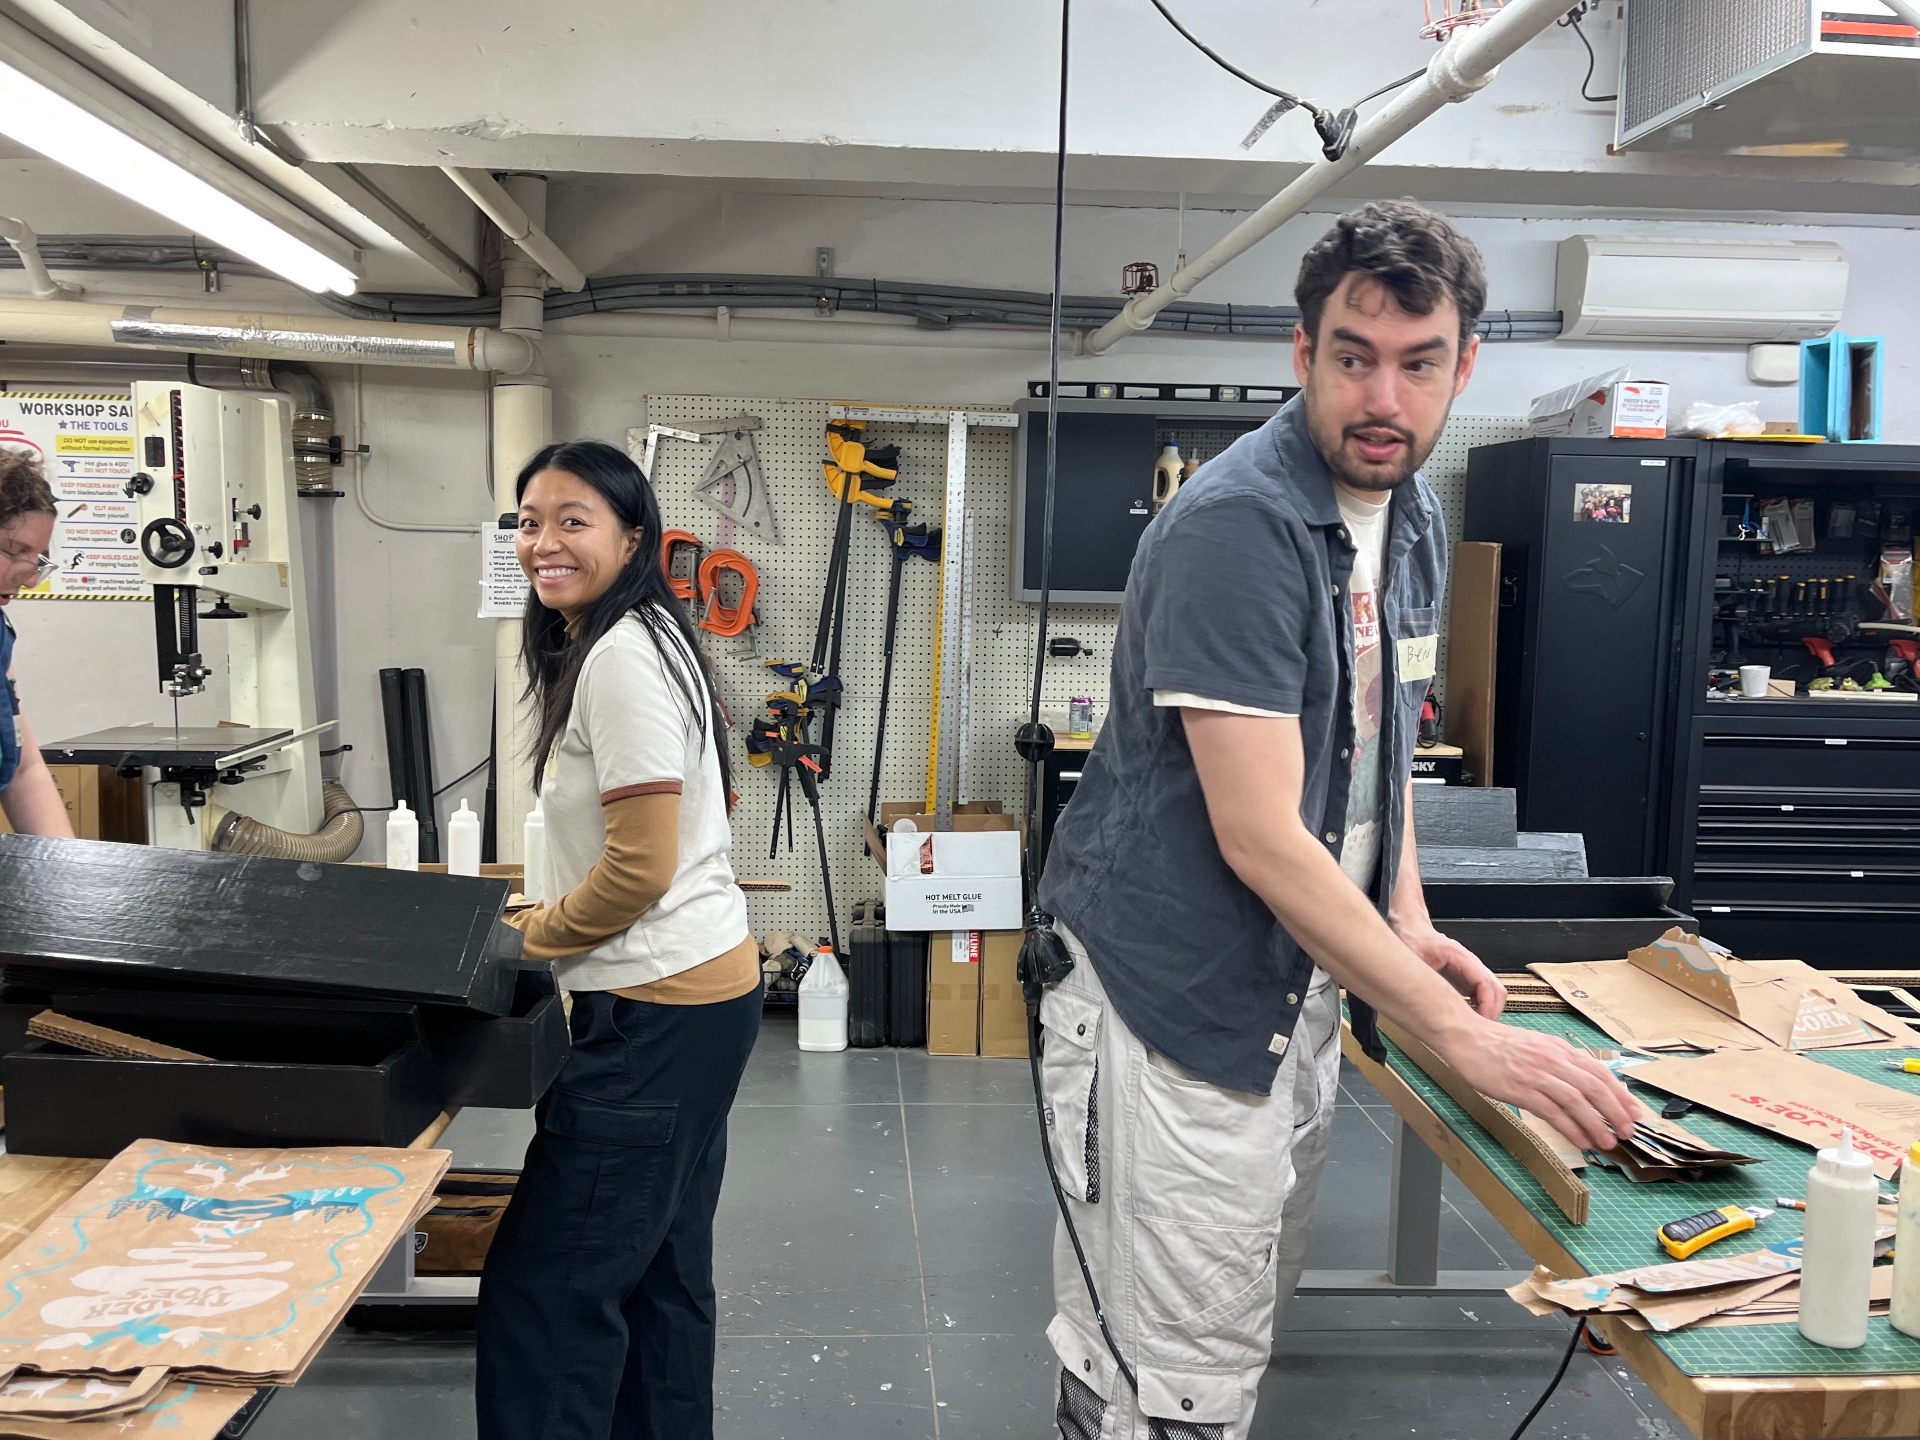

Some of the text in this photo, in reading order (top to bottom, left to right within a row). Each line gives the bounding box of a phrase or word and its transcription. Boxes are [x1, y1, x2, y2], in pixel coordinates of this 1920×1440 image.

[19, 402, 104, 417] WORKSHOP
[70, 421, 128, 431] THE TOOLS
[969, 932, 978, 958] ULINE
[83, 1293, 233, 1320] TRADER
